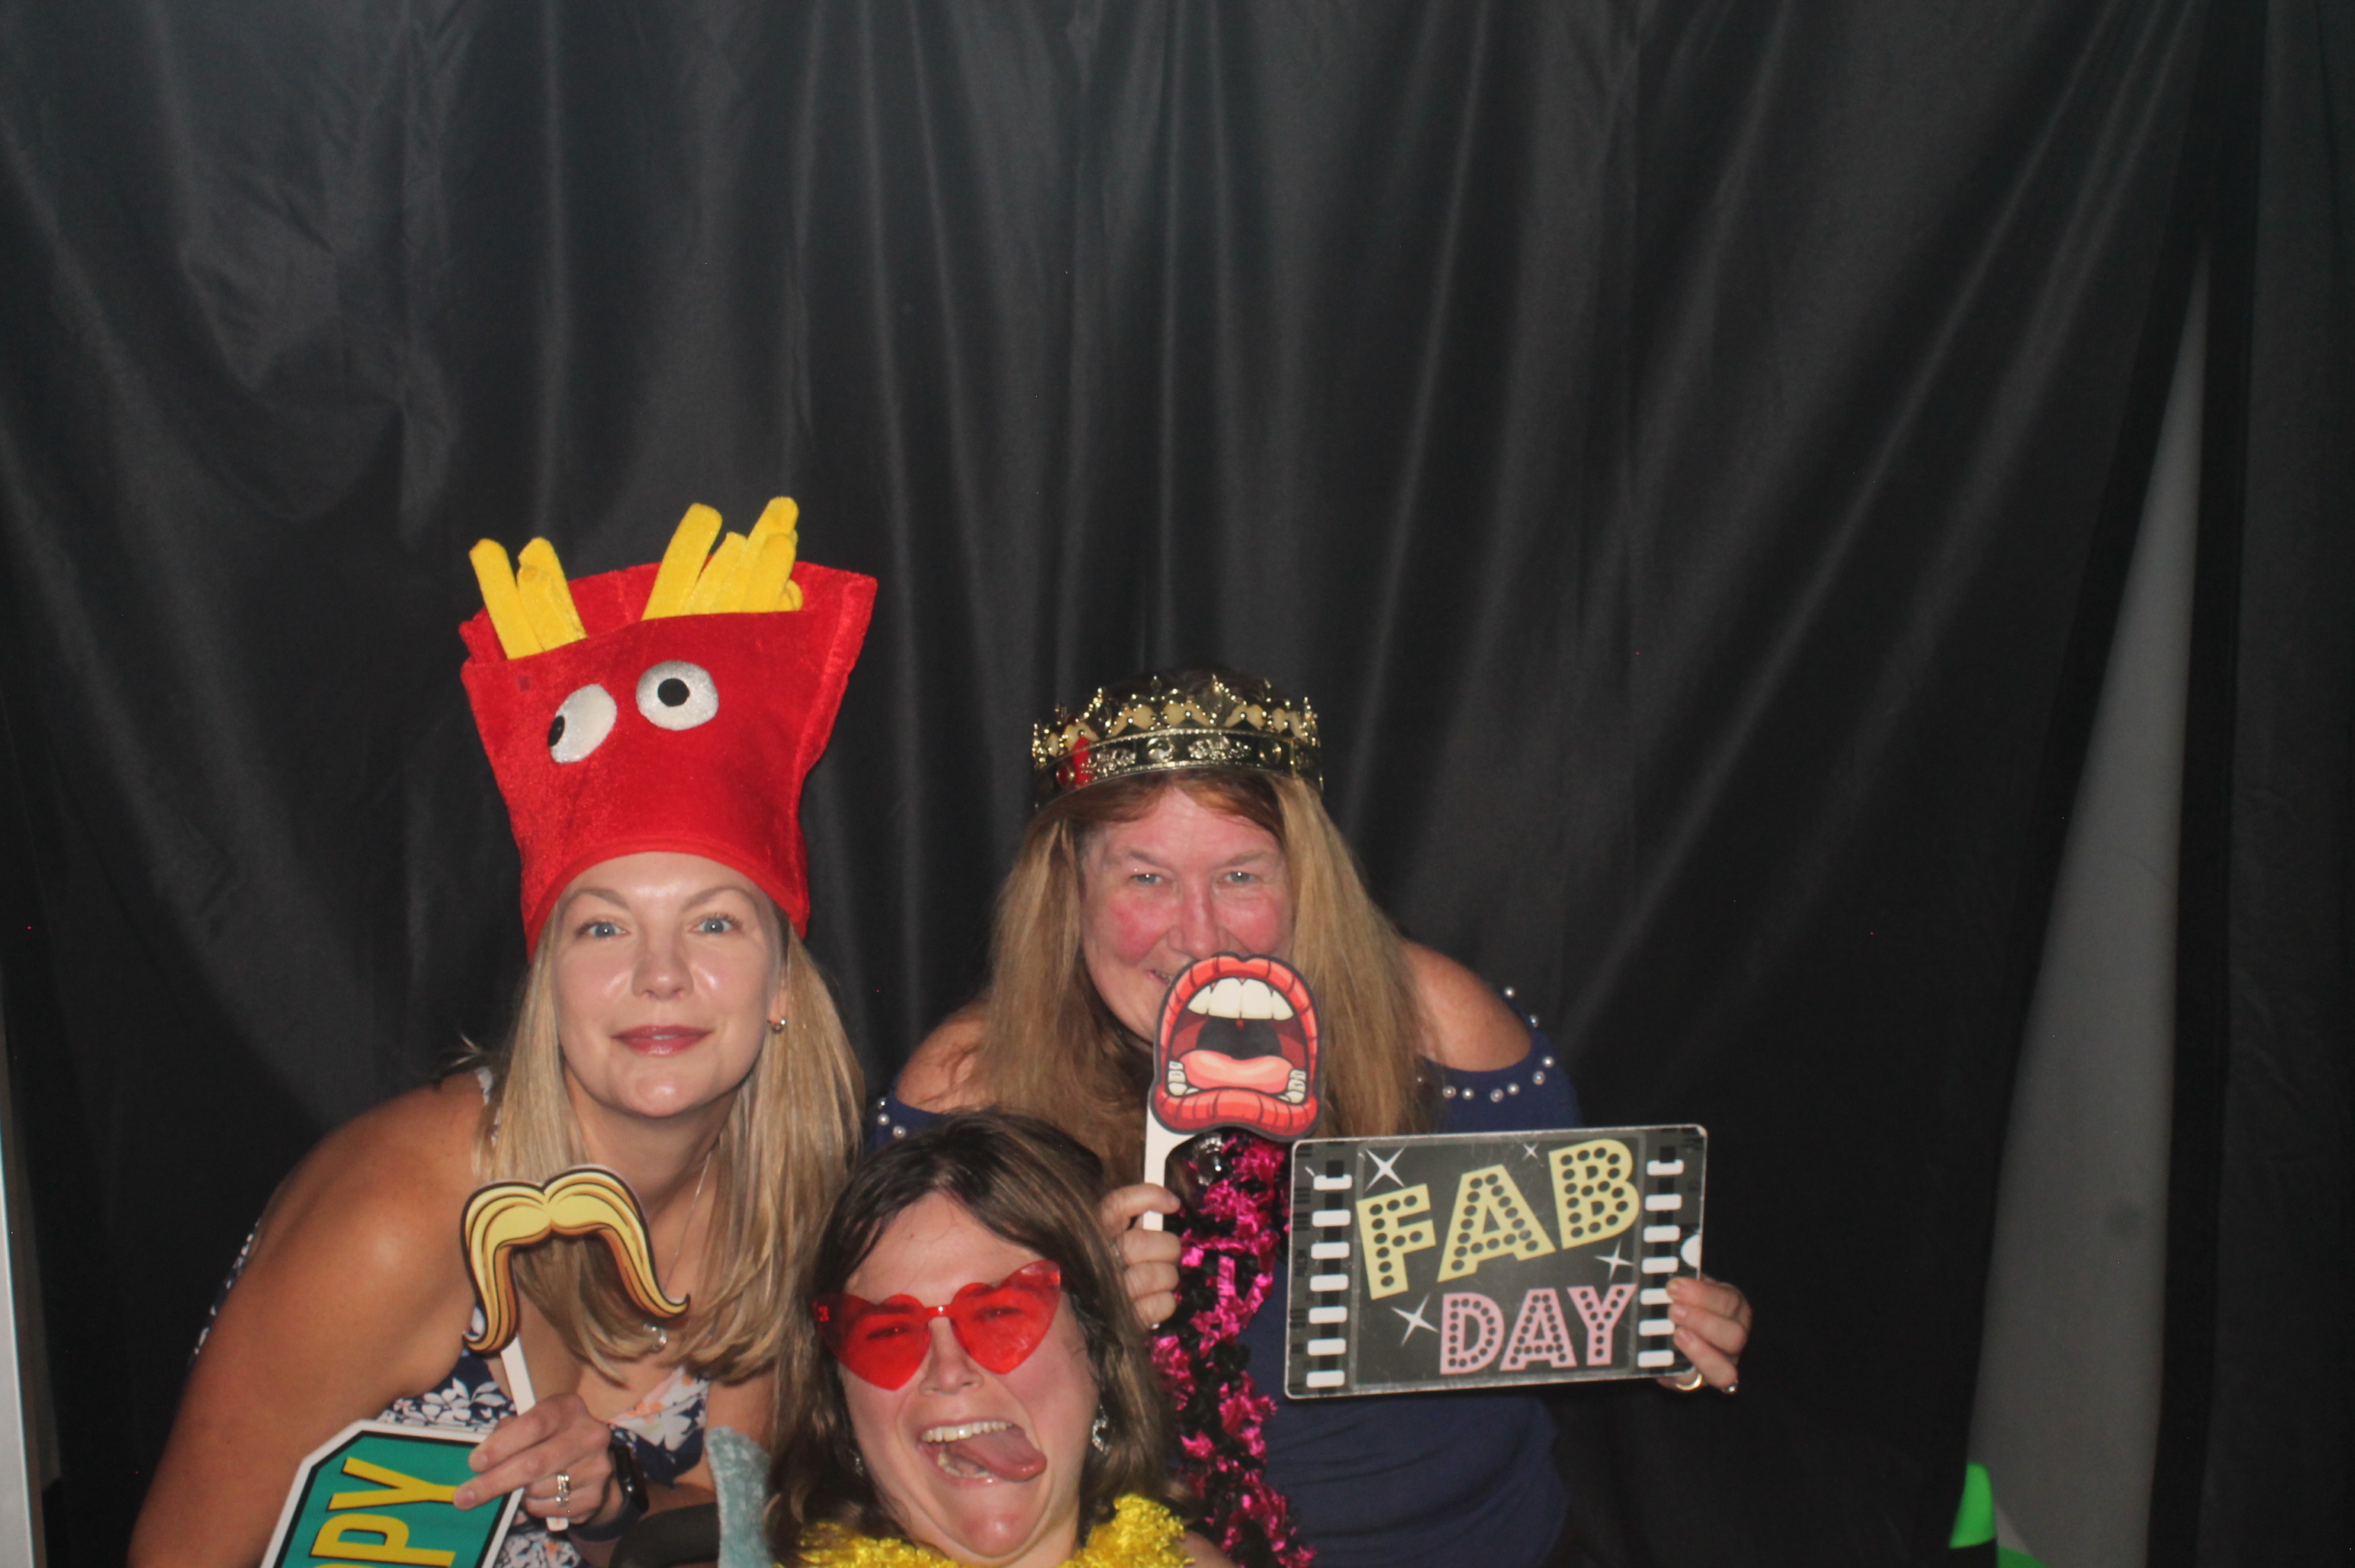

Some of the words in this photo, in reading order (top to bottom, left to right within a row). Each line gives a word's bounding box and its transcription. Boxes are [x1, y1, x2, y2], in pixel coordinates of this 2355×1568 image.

[1356, 1139, 1640, 1300] FAB
[1440, 1284, 1639, 1376] DAY
[310, 1457, 458, 1568] PY
